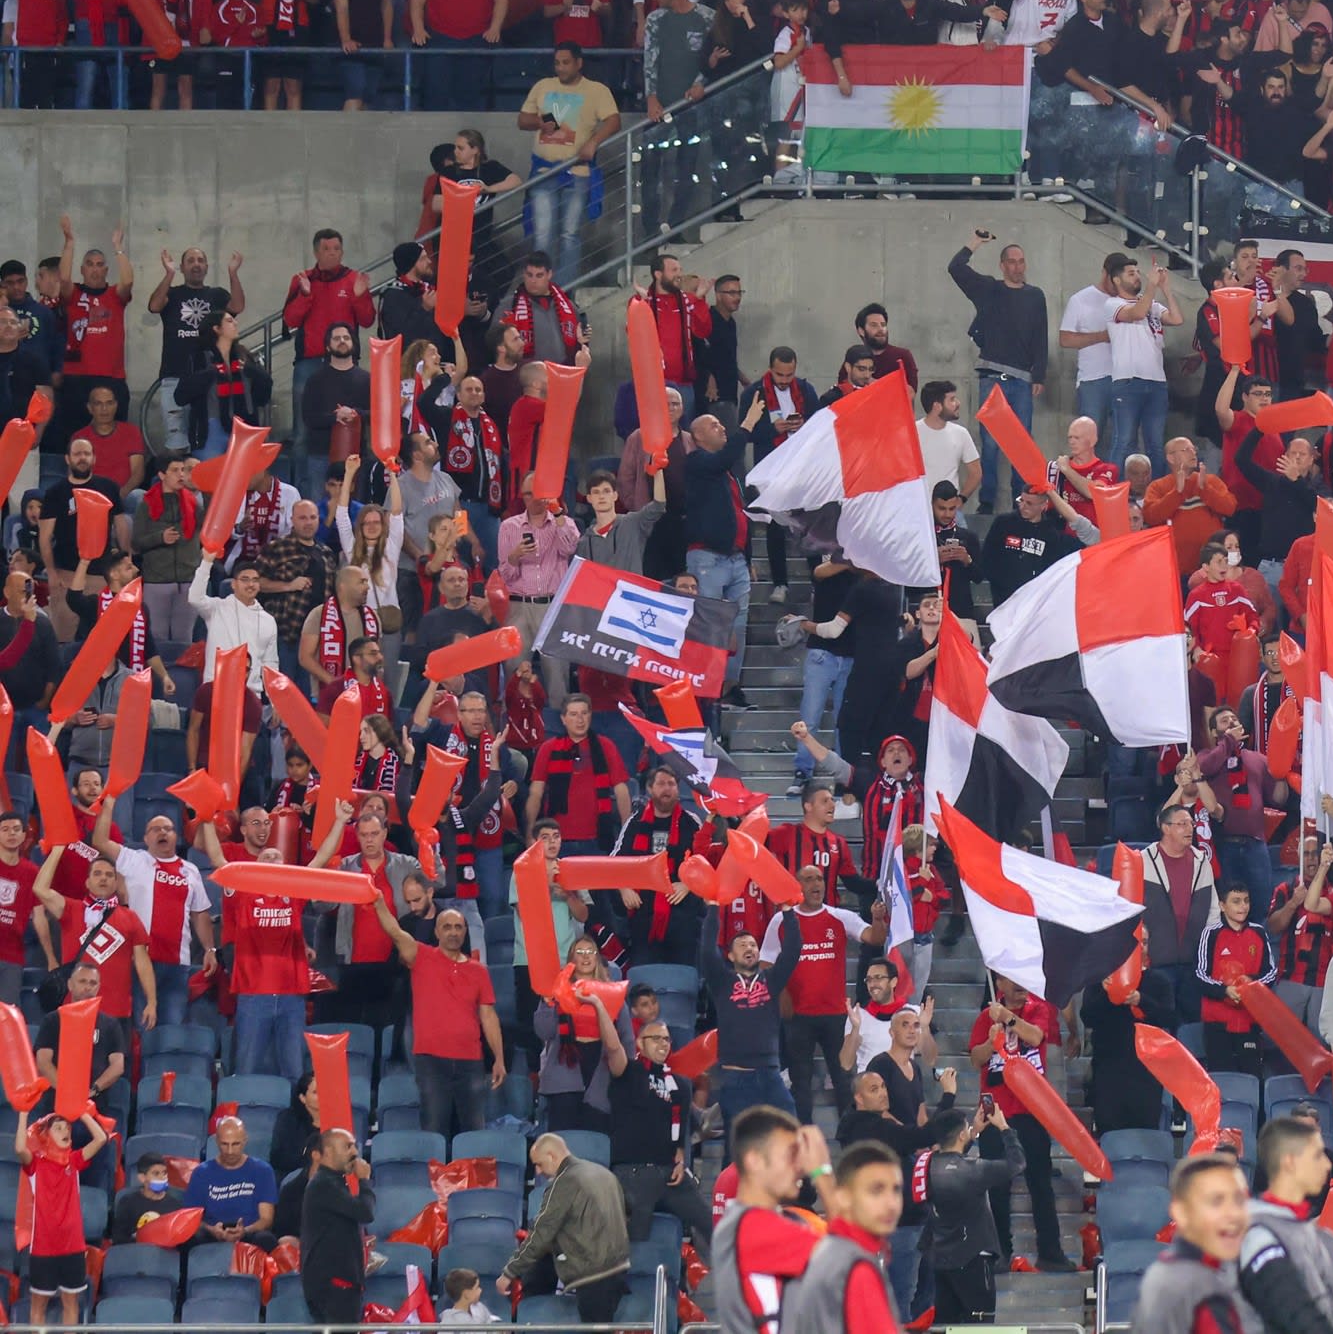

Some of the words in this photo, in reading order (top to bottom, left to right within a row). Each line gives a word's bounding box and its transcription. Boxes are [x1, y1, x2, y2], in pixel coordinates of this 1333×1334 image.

[813, 850, 831, 867] 10
[259, 918, 271, 927] FLY
[271, 916, 292, 927] BETTER
